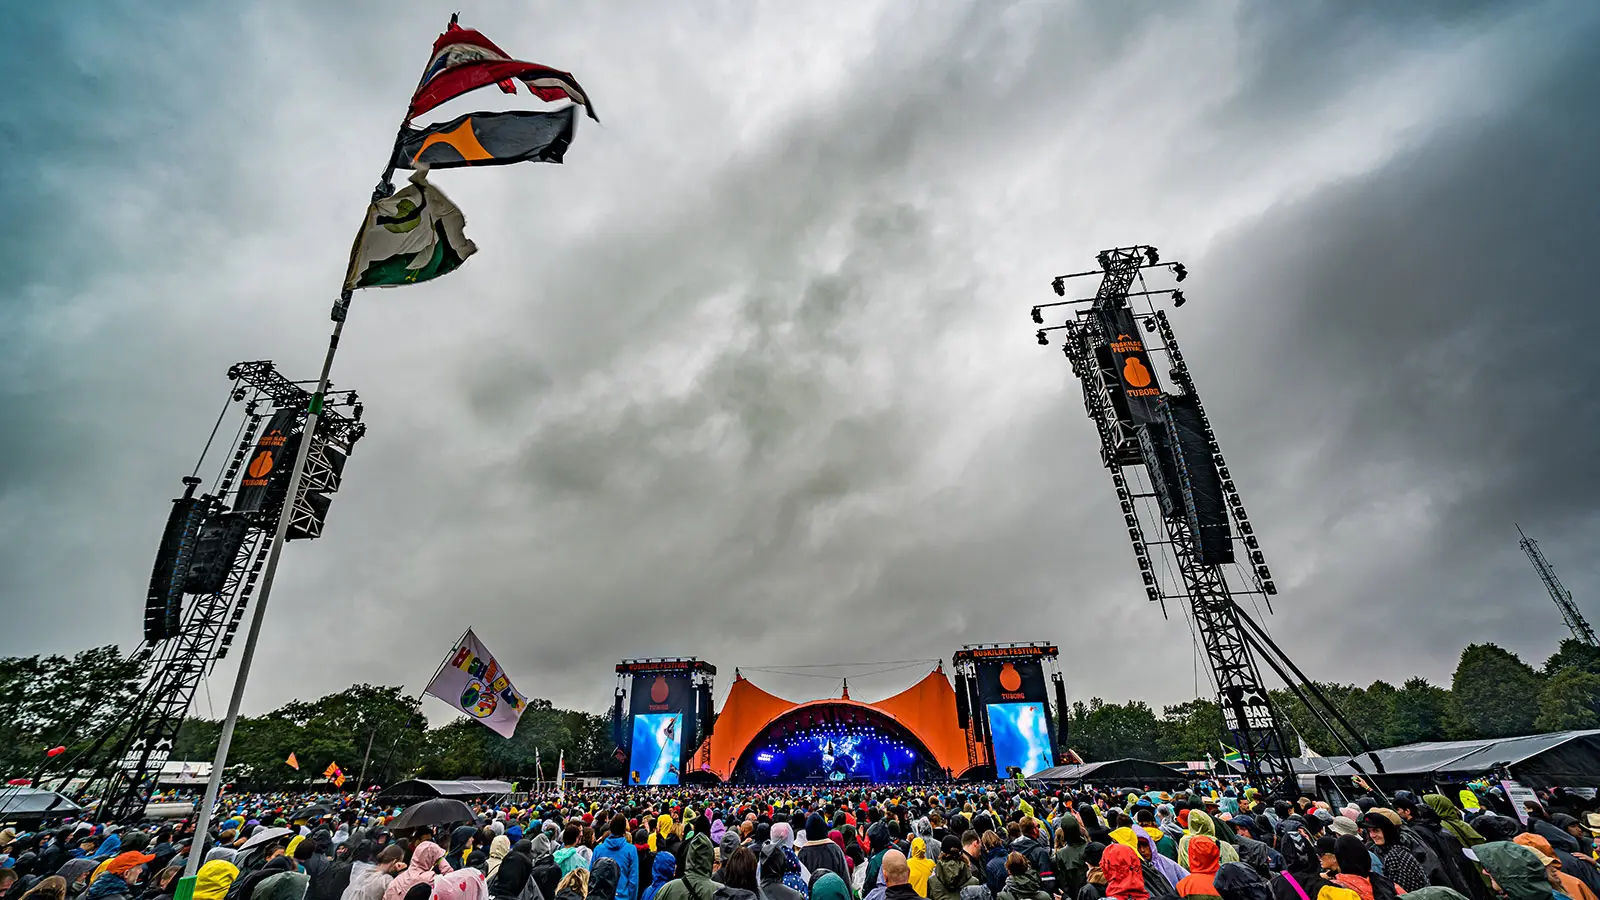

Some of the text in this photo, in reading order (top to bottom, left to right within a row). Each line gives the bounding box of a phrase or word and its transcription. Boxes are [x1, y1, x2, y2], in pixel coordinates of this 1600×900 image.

[1127, 387, 1160, 397] TUBORG
[973, 647, 1043, 657] ROSKILDE FESTIVAL
[1222, 707, 1237, 720] BAR
[1242, 705, 1271, 718] BAR
[1247, 717, 1273, 728] EAST
[125, 750, 144, 760] BAR
[148, 749, 170, 760] BAR
[121, 760, 140, 769] WEST
[145, 760, 166, 768] WEST
